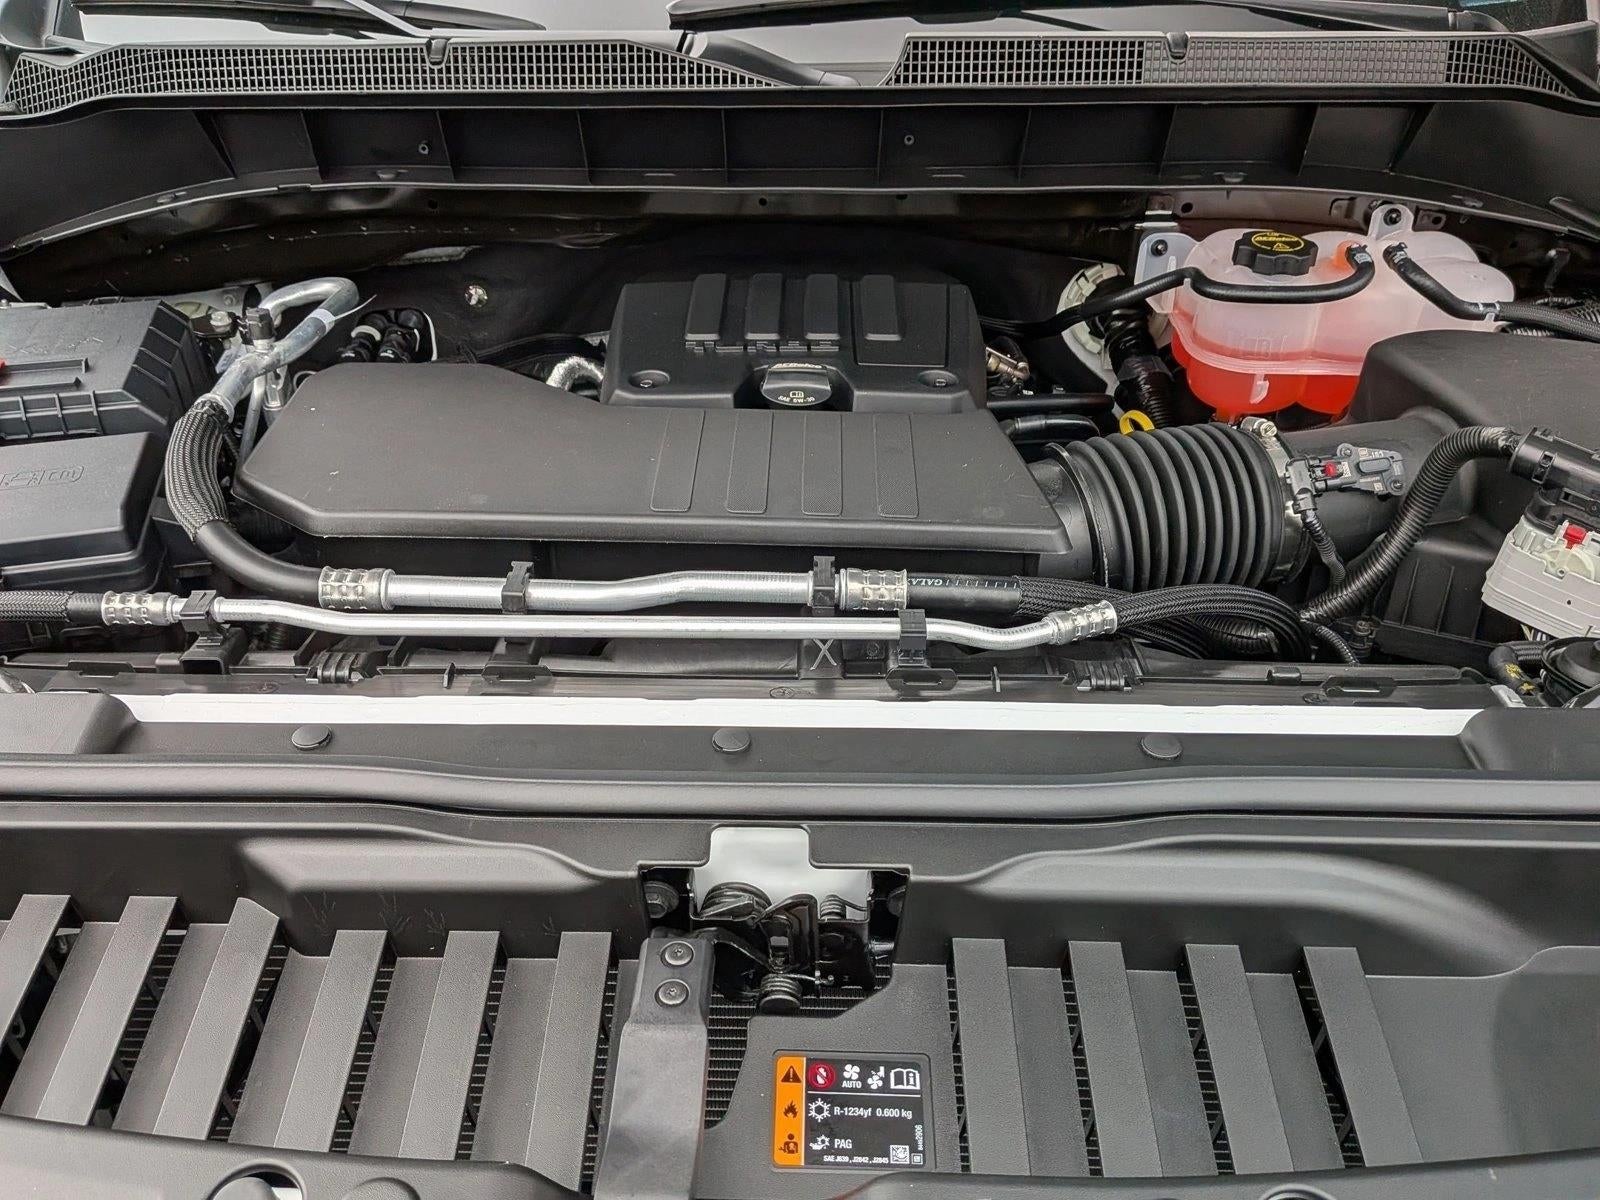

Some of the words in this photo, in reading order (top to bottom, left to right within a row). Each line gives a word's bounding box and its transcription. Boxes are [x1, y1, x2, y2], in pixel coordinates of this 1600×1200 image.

[842, 1080, 862, 1089] AUTO
[834, 1106, 872, 1118] R-1234yf
[876, 1108, 900, 1117] 0.600
[901, 1109, 912, 1119] kg
[834, 1138, 853, 1149] PAG
